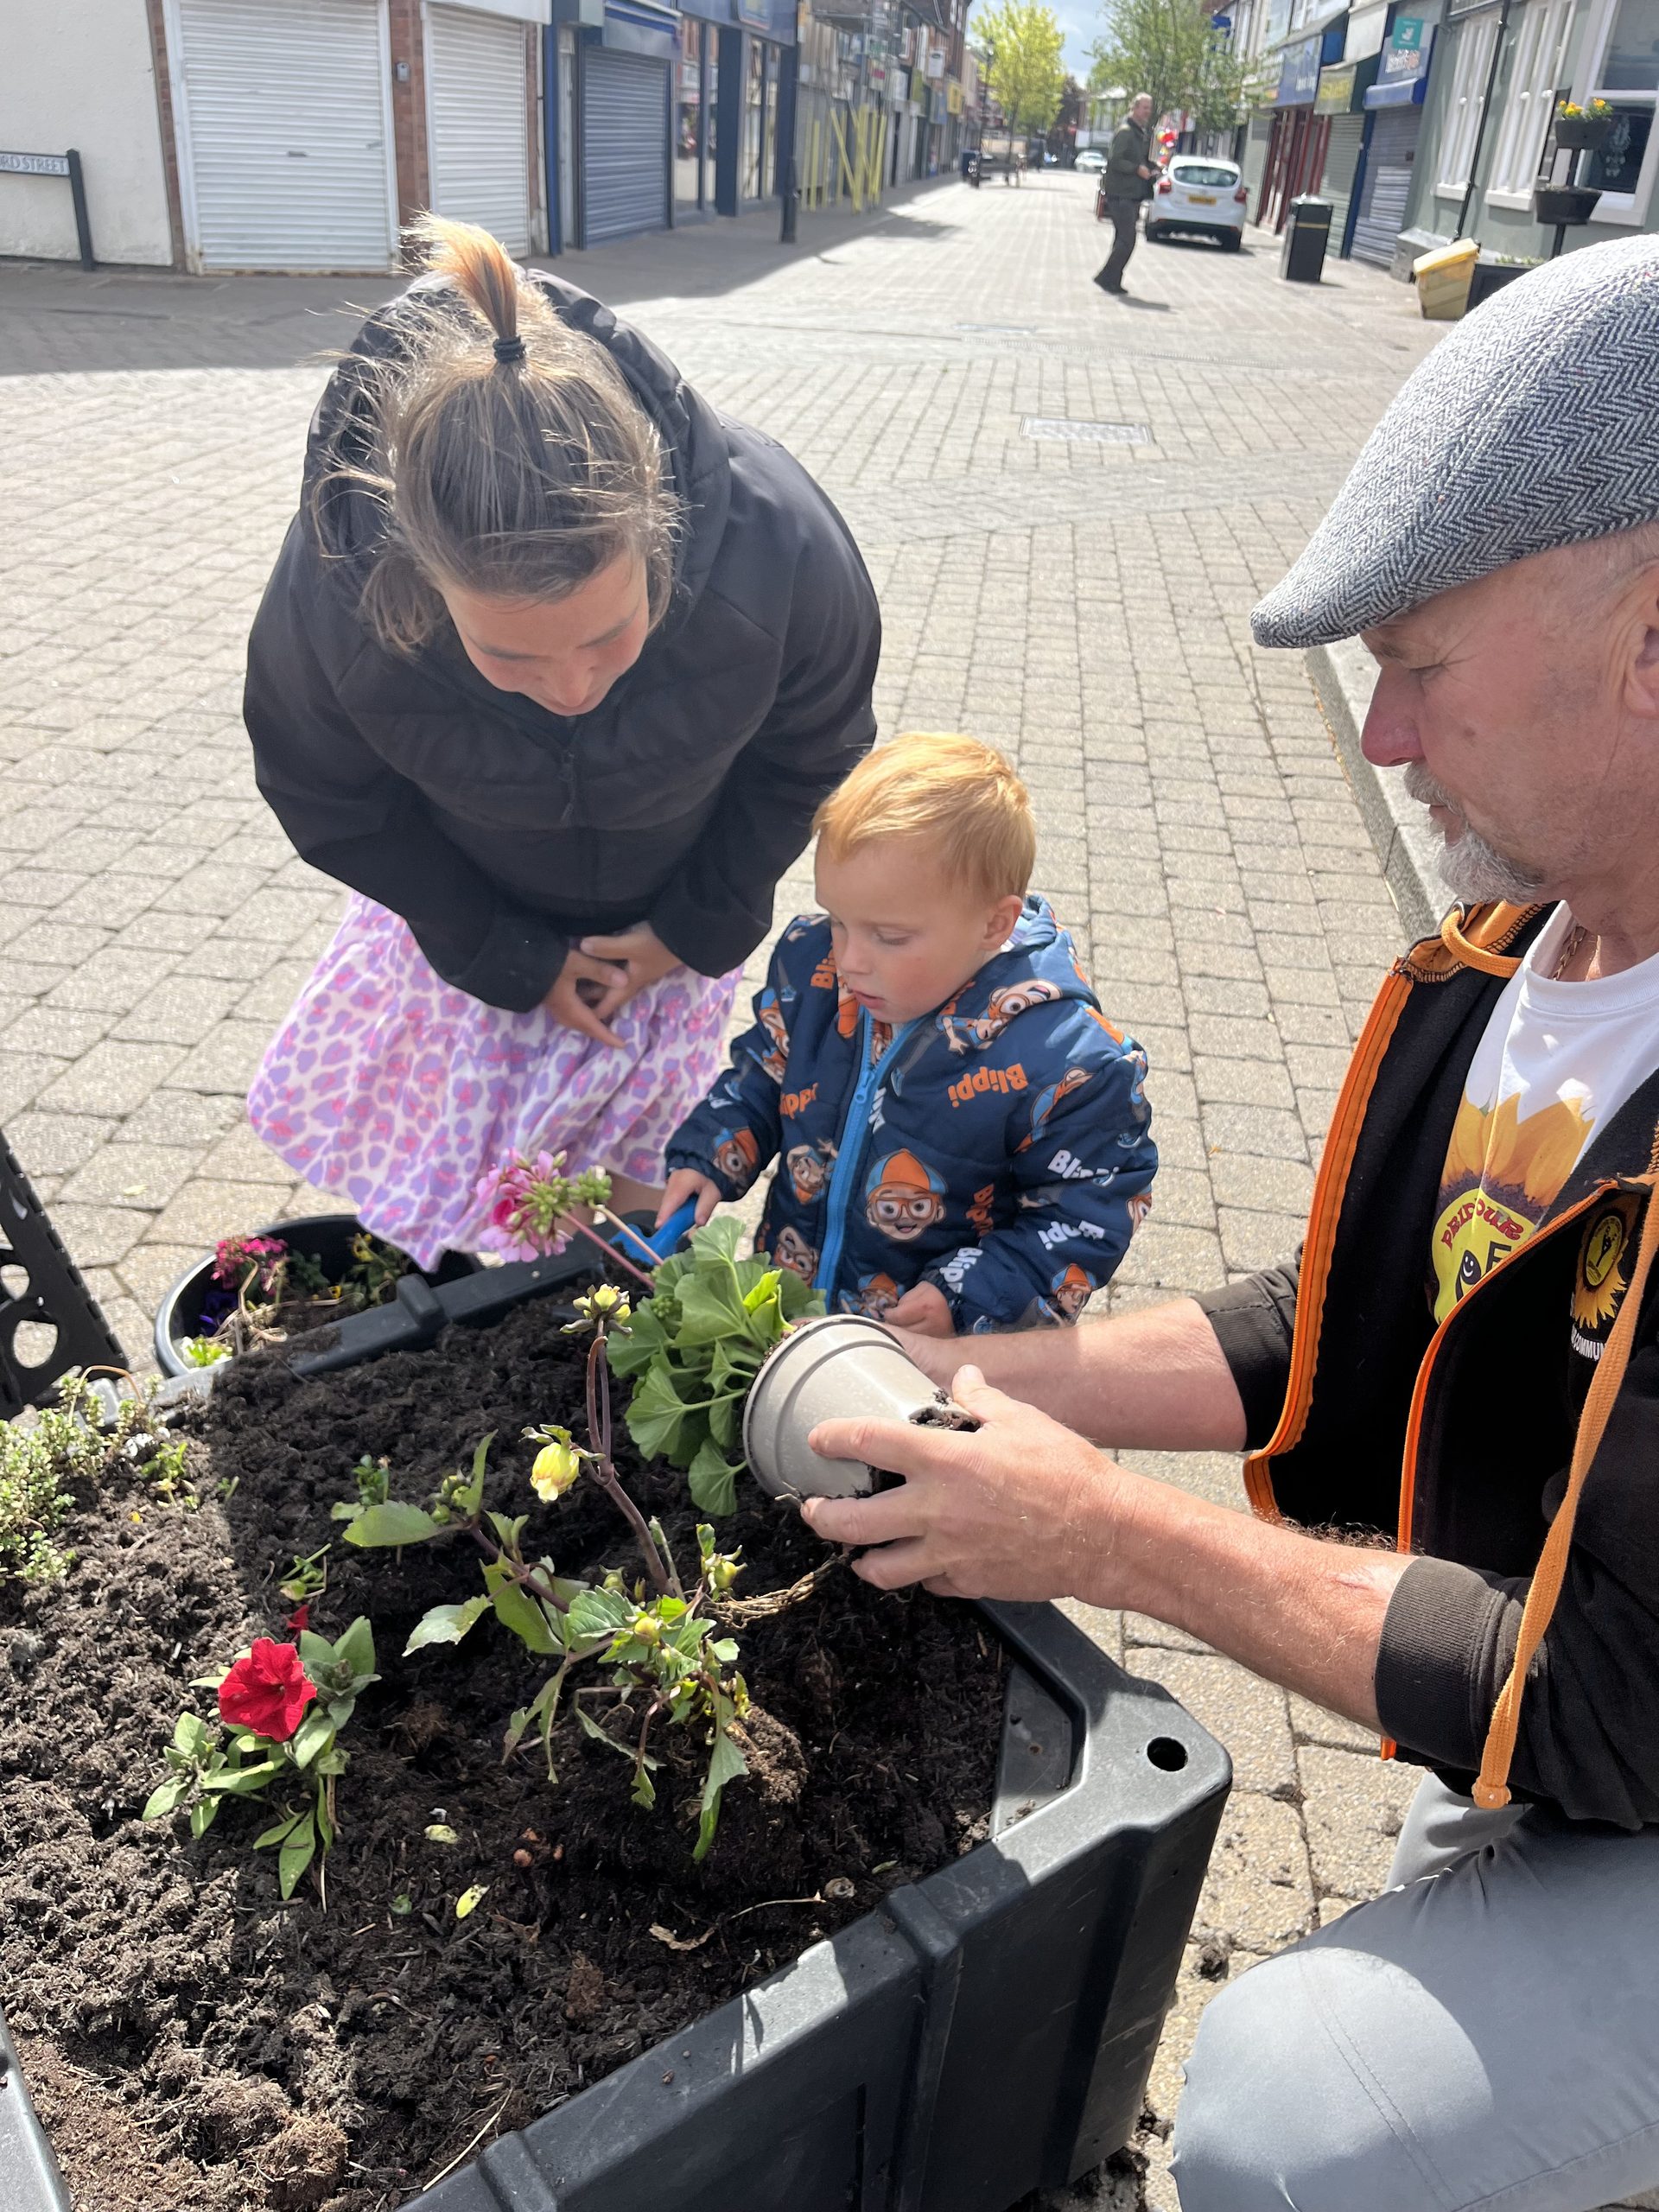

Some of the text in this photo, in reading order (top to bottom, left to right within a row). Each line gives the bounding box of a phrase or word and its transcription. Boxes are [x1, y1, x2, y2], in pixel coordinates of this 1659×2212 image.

[0, 154, 64, 173] RD STREET
[947, 1063, 1029, 1109] Blippi
